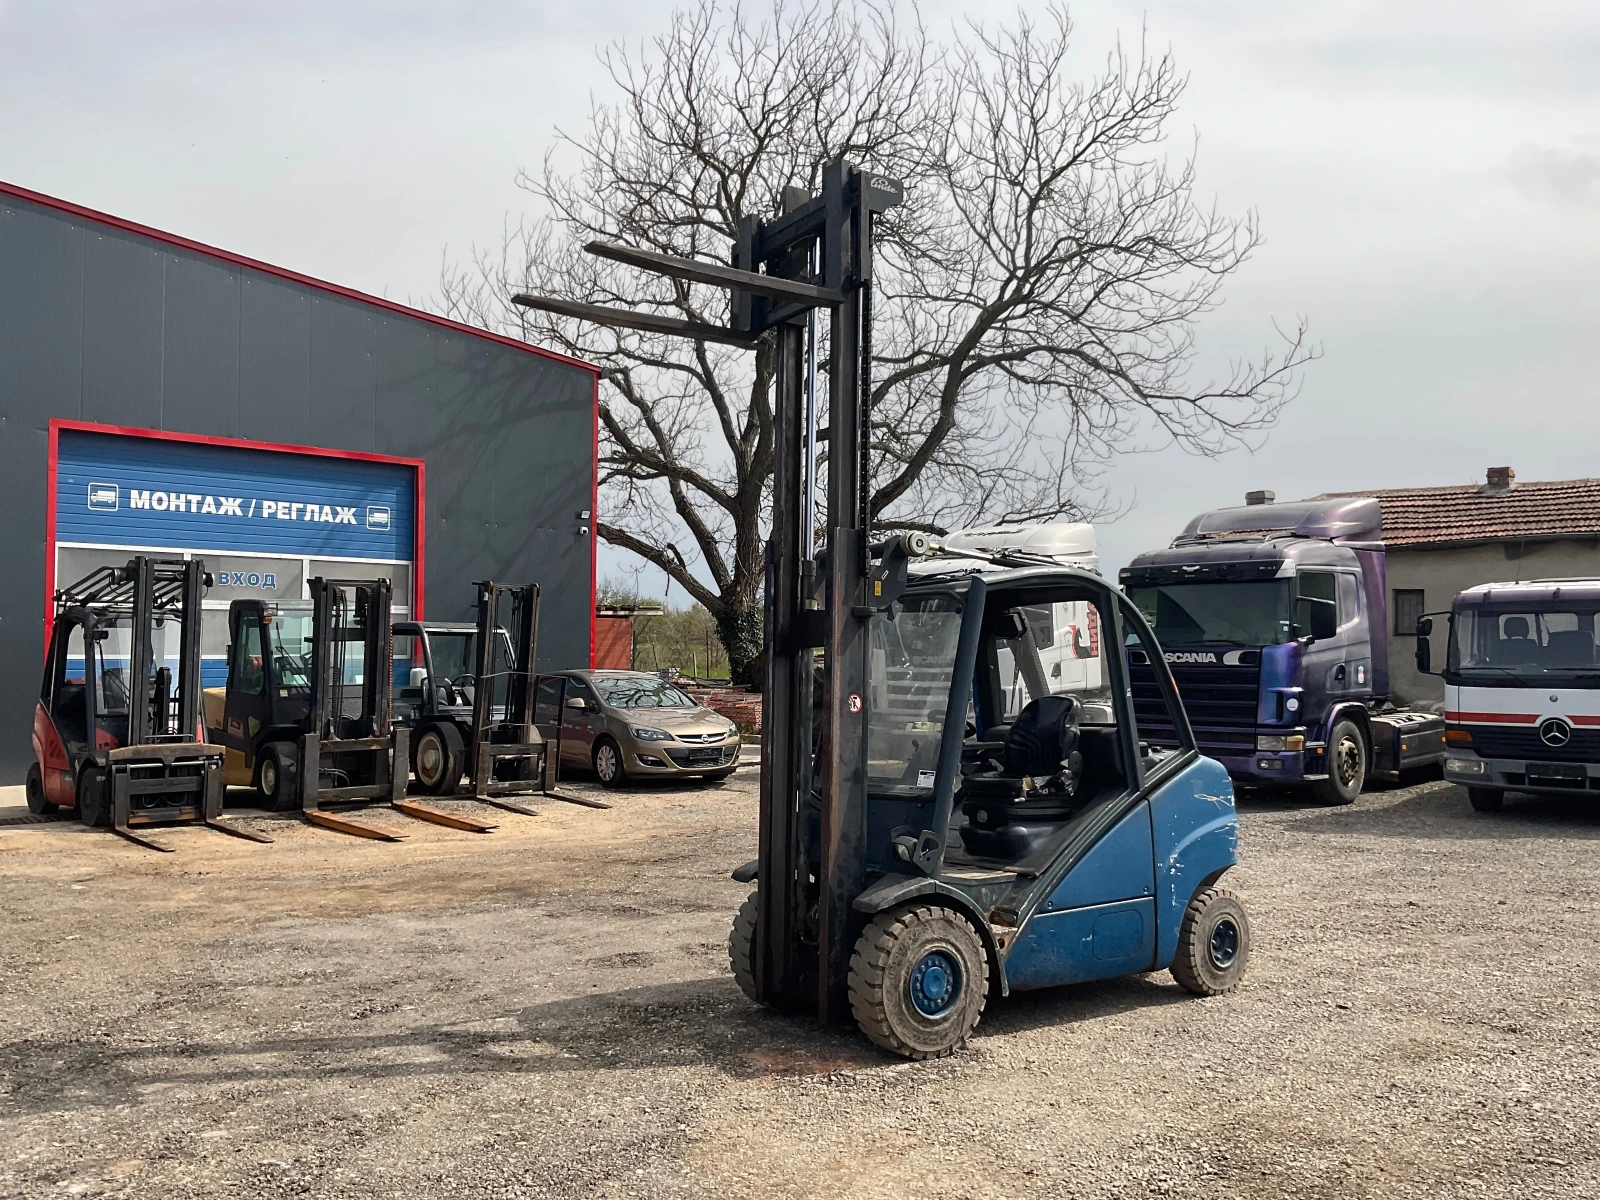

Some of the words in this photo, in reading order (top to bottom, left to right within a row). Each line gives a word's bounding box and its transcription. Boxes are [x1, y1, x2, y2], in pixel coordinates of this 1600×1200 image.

[870, 176, 899, 194] Linde
[129, 489, 244, 516] МОНТАЖ
[262, 500, 358, 525] РЕГЛАЖ
[218, 570, 277, 590] ВХОД
[1164, 652, 1217, 663] SCANIA
